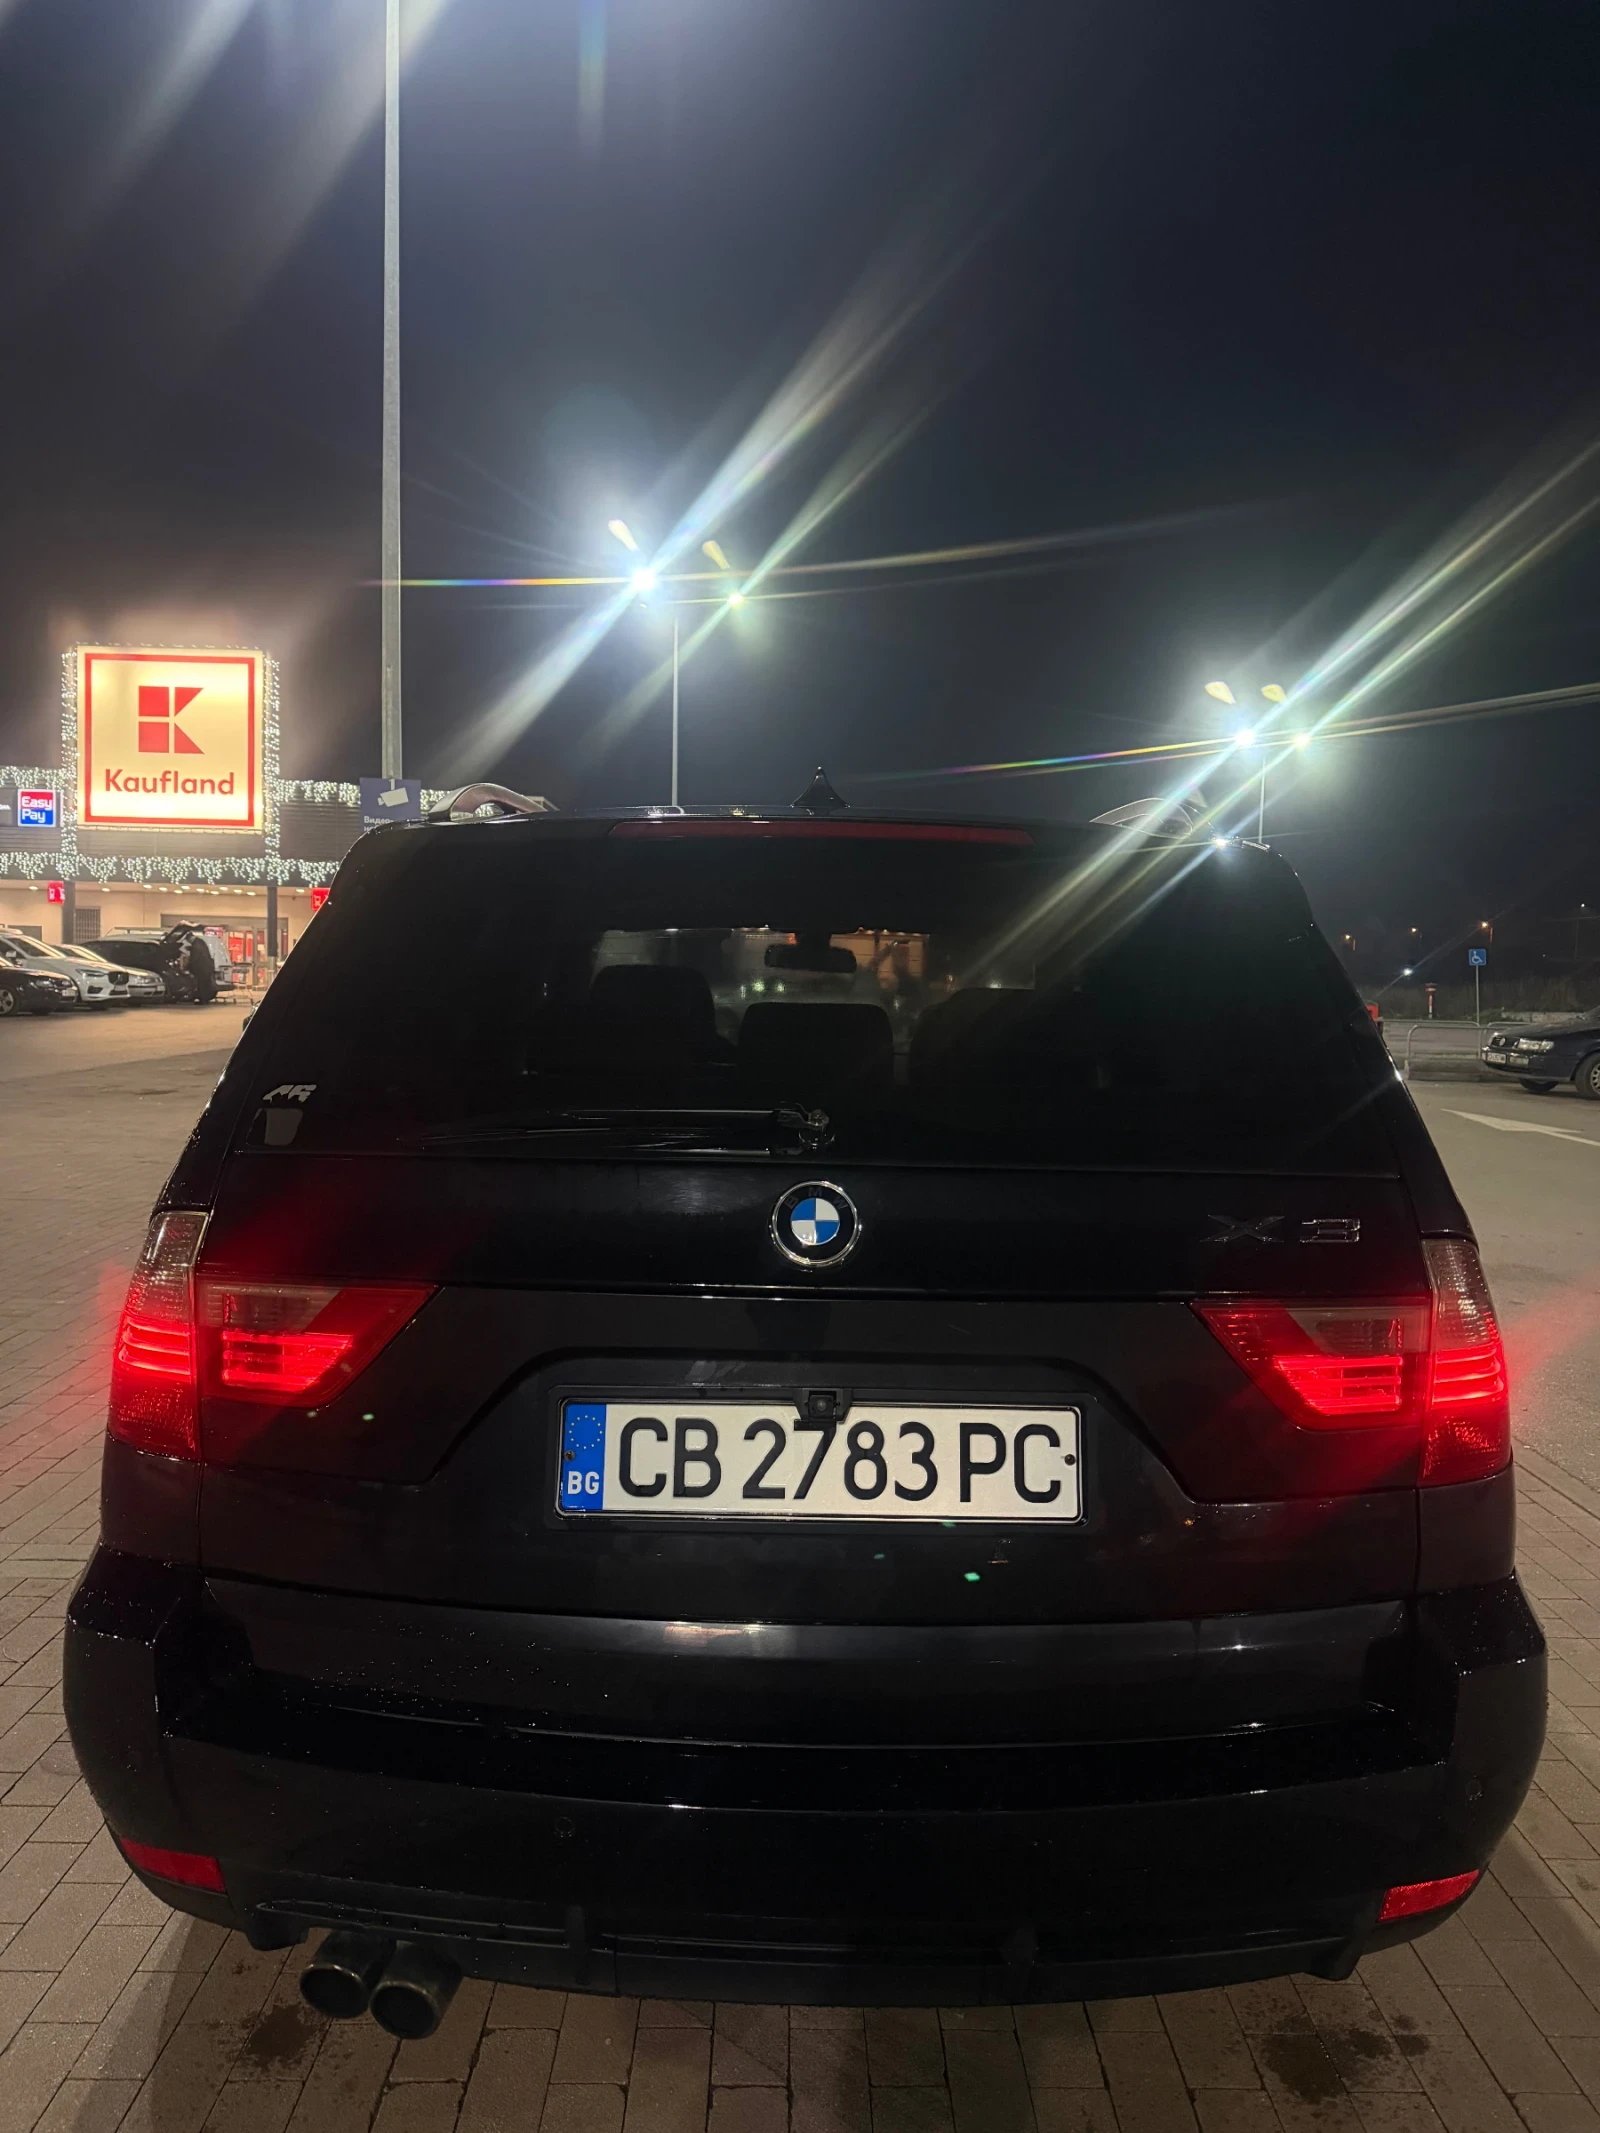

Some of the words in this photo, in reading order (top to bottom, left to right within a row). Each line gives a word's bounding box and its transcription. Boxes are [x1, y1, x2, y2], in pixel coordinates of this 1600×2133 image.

[104, 768, 235, 795] Kaufland
[21, 795, 53, 811] Easy
[22, 808, 46, 824] Pay
[783, 1186, 849, 1210] BMW
[1199, 1214, 1361, 1243] X3
[619, 1417, 722, 1498] CB
[743, 1418, 939, 1502] 2783
[959, 1422, 1062, 1504] PC
[567, 1470, 600, 1495] BG
